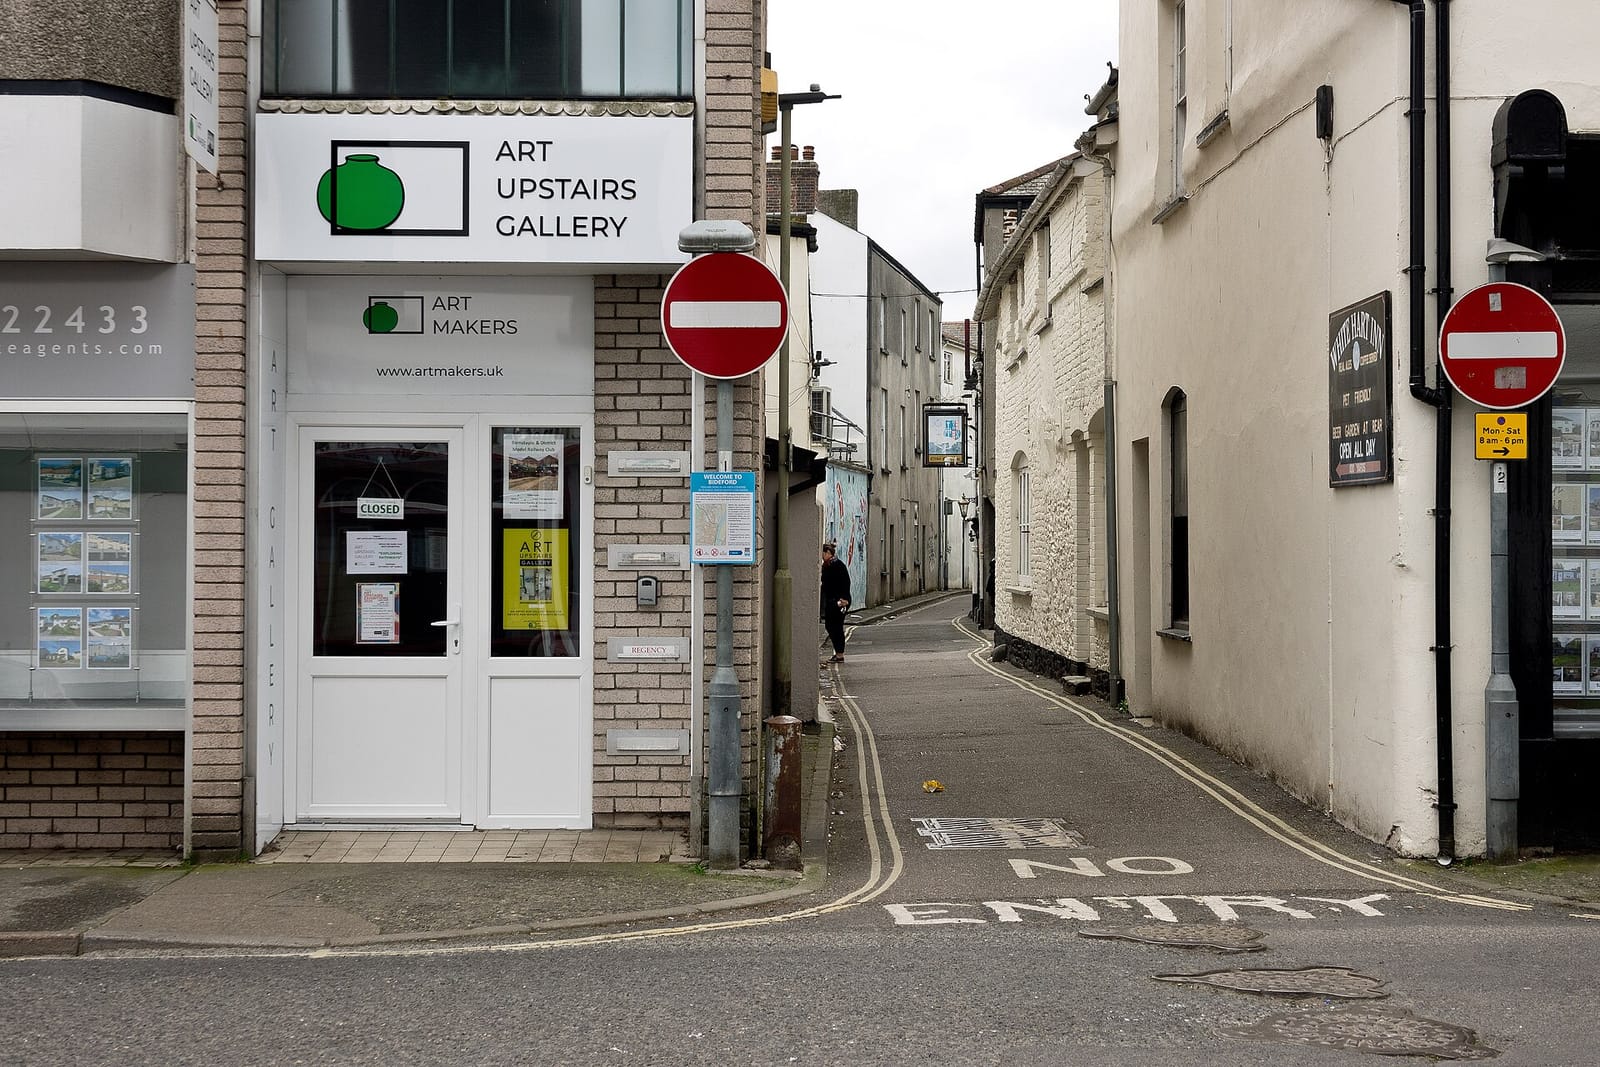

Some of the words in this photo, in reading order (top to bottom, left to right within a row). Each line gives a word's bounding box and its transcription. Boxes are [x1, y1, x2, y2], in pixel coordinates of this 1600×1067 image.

[190, 28, 215, 72] UPSTAIRS
[190, 66, 213, 105] GALLERY
[495, 140, 553, 162] ART
[497, 177, 637, 200] UPSTAIRS
[496, 215, 628, 237] GALLERY
[432, 296, 472, 311] ART
[1, 305, 148, 334] 22433
[433, 319, 518, 335] MAKERS
[0, 342, 163, 357] eagents.com
[1330, 314, 1352, 371] WHITE
[1350, 311, 1370, 340] HART
[1369, 316, 1385, 360] INN
[376, 365, 504, 377] www.artmakers.uk
[1355, 387, 1372, 405] FRIENDLY
[1332, 426, 1342, 439] BEER
[1345, 422, 1360, 438] GARDEN
[1363, 420, 1369, 434] AT
[1371, 418, 1383, 433] REAR
[1482, 427, 1500, 435] Mon
[1506, 427, 1521, 435] Sat
[1339, 441, 1352, 460] OPEN
[1353, 439, 1363, 458] ALL
[1365, 438, 1377, 456] DAY
[1511, 438, 1524, 446] pm
[1497, 471, 1506, 483] 2
[360, 503, 400, 514] CLOSED
[520, 541, 552, 552] ART
[1007, 856, 1194, 879] NO
[882, 892, 1391, 925] ENTRY
